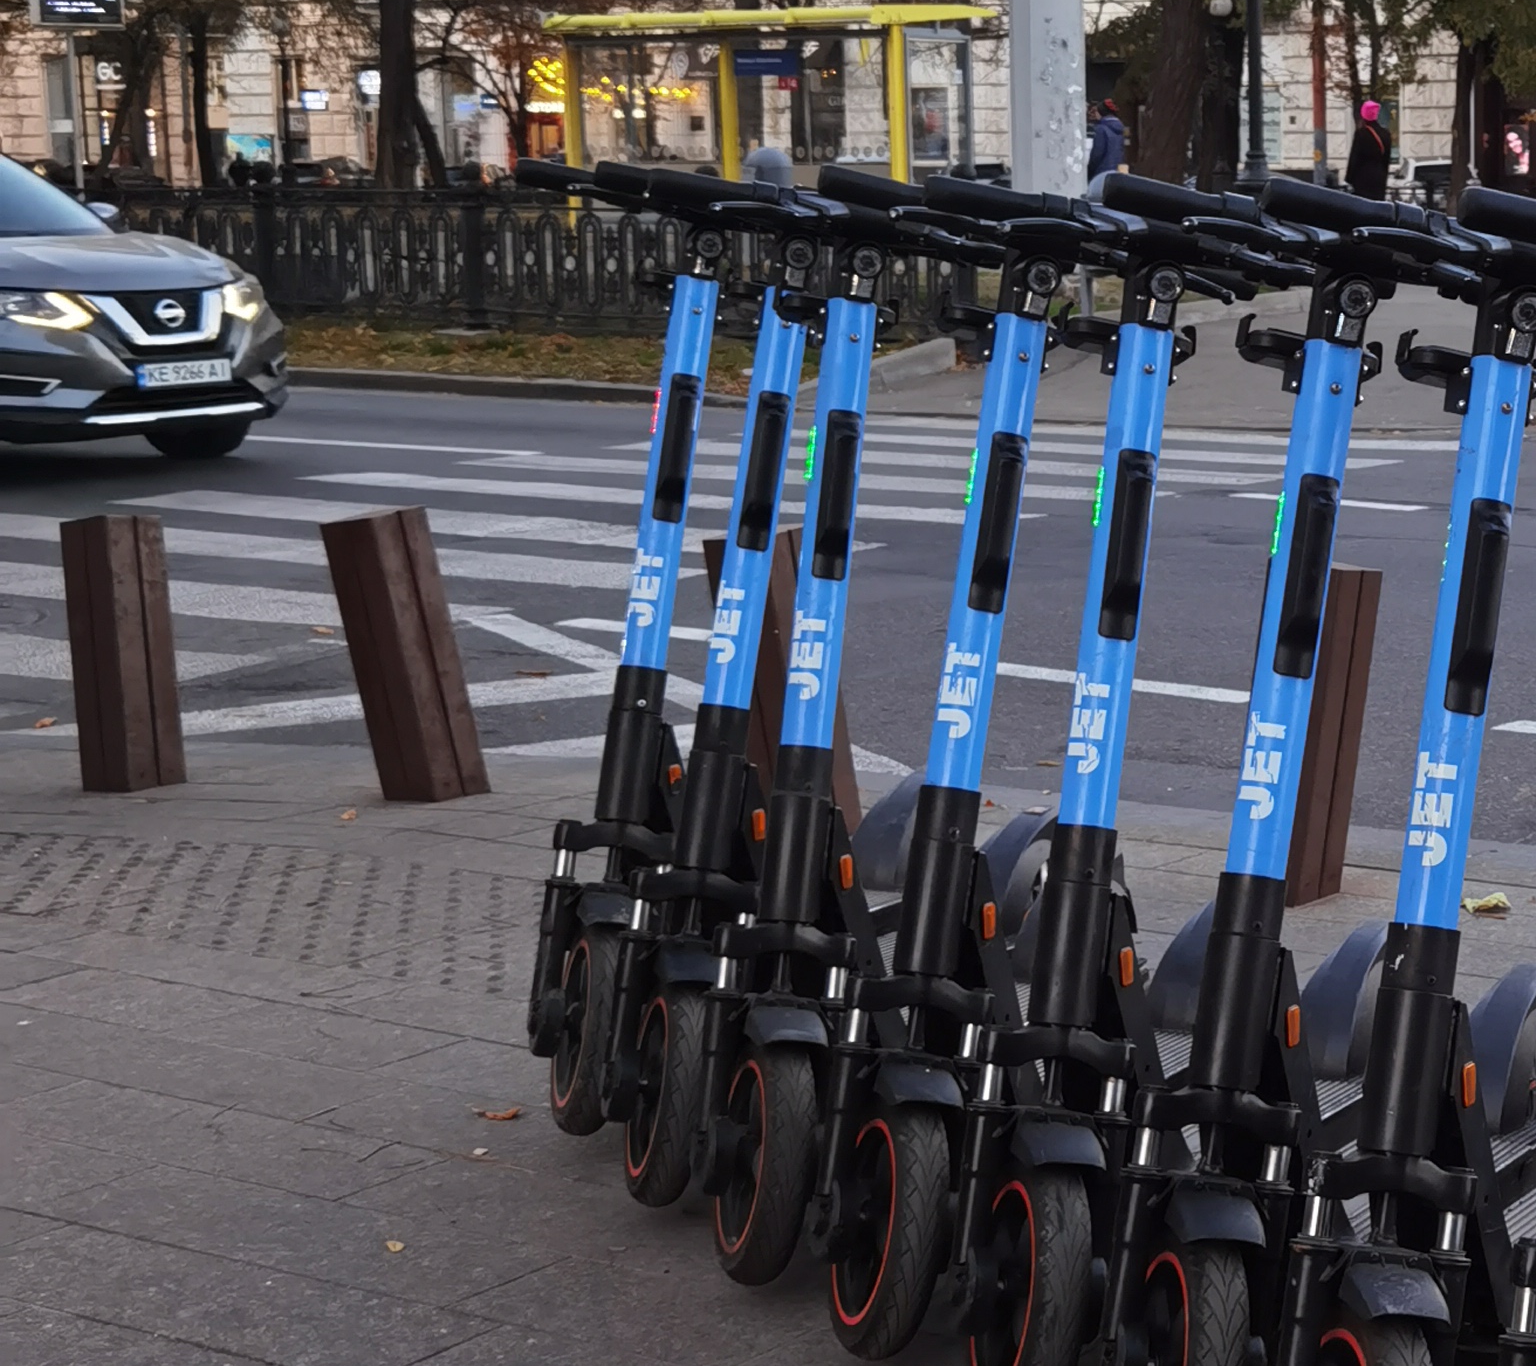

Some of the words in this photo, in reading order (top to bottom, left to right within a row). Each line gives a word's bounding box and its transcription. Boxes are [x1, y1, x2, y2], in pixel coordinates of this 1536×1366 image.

[148, 366, 170, 383] KE
[628, 548, 664, 627] JET
[710, 580, 745, 664] JET
[788, 610, 827, 701] JET
[937, 642, 981, 739] JET
[1068, 672, 1110, 773] JET
[1240, 710, 1287, 819] JET
[1408, 751, 1457, 867] JET
